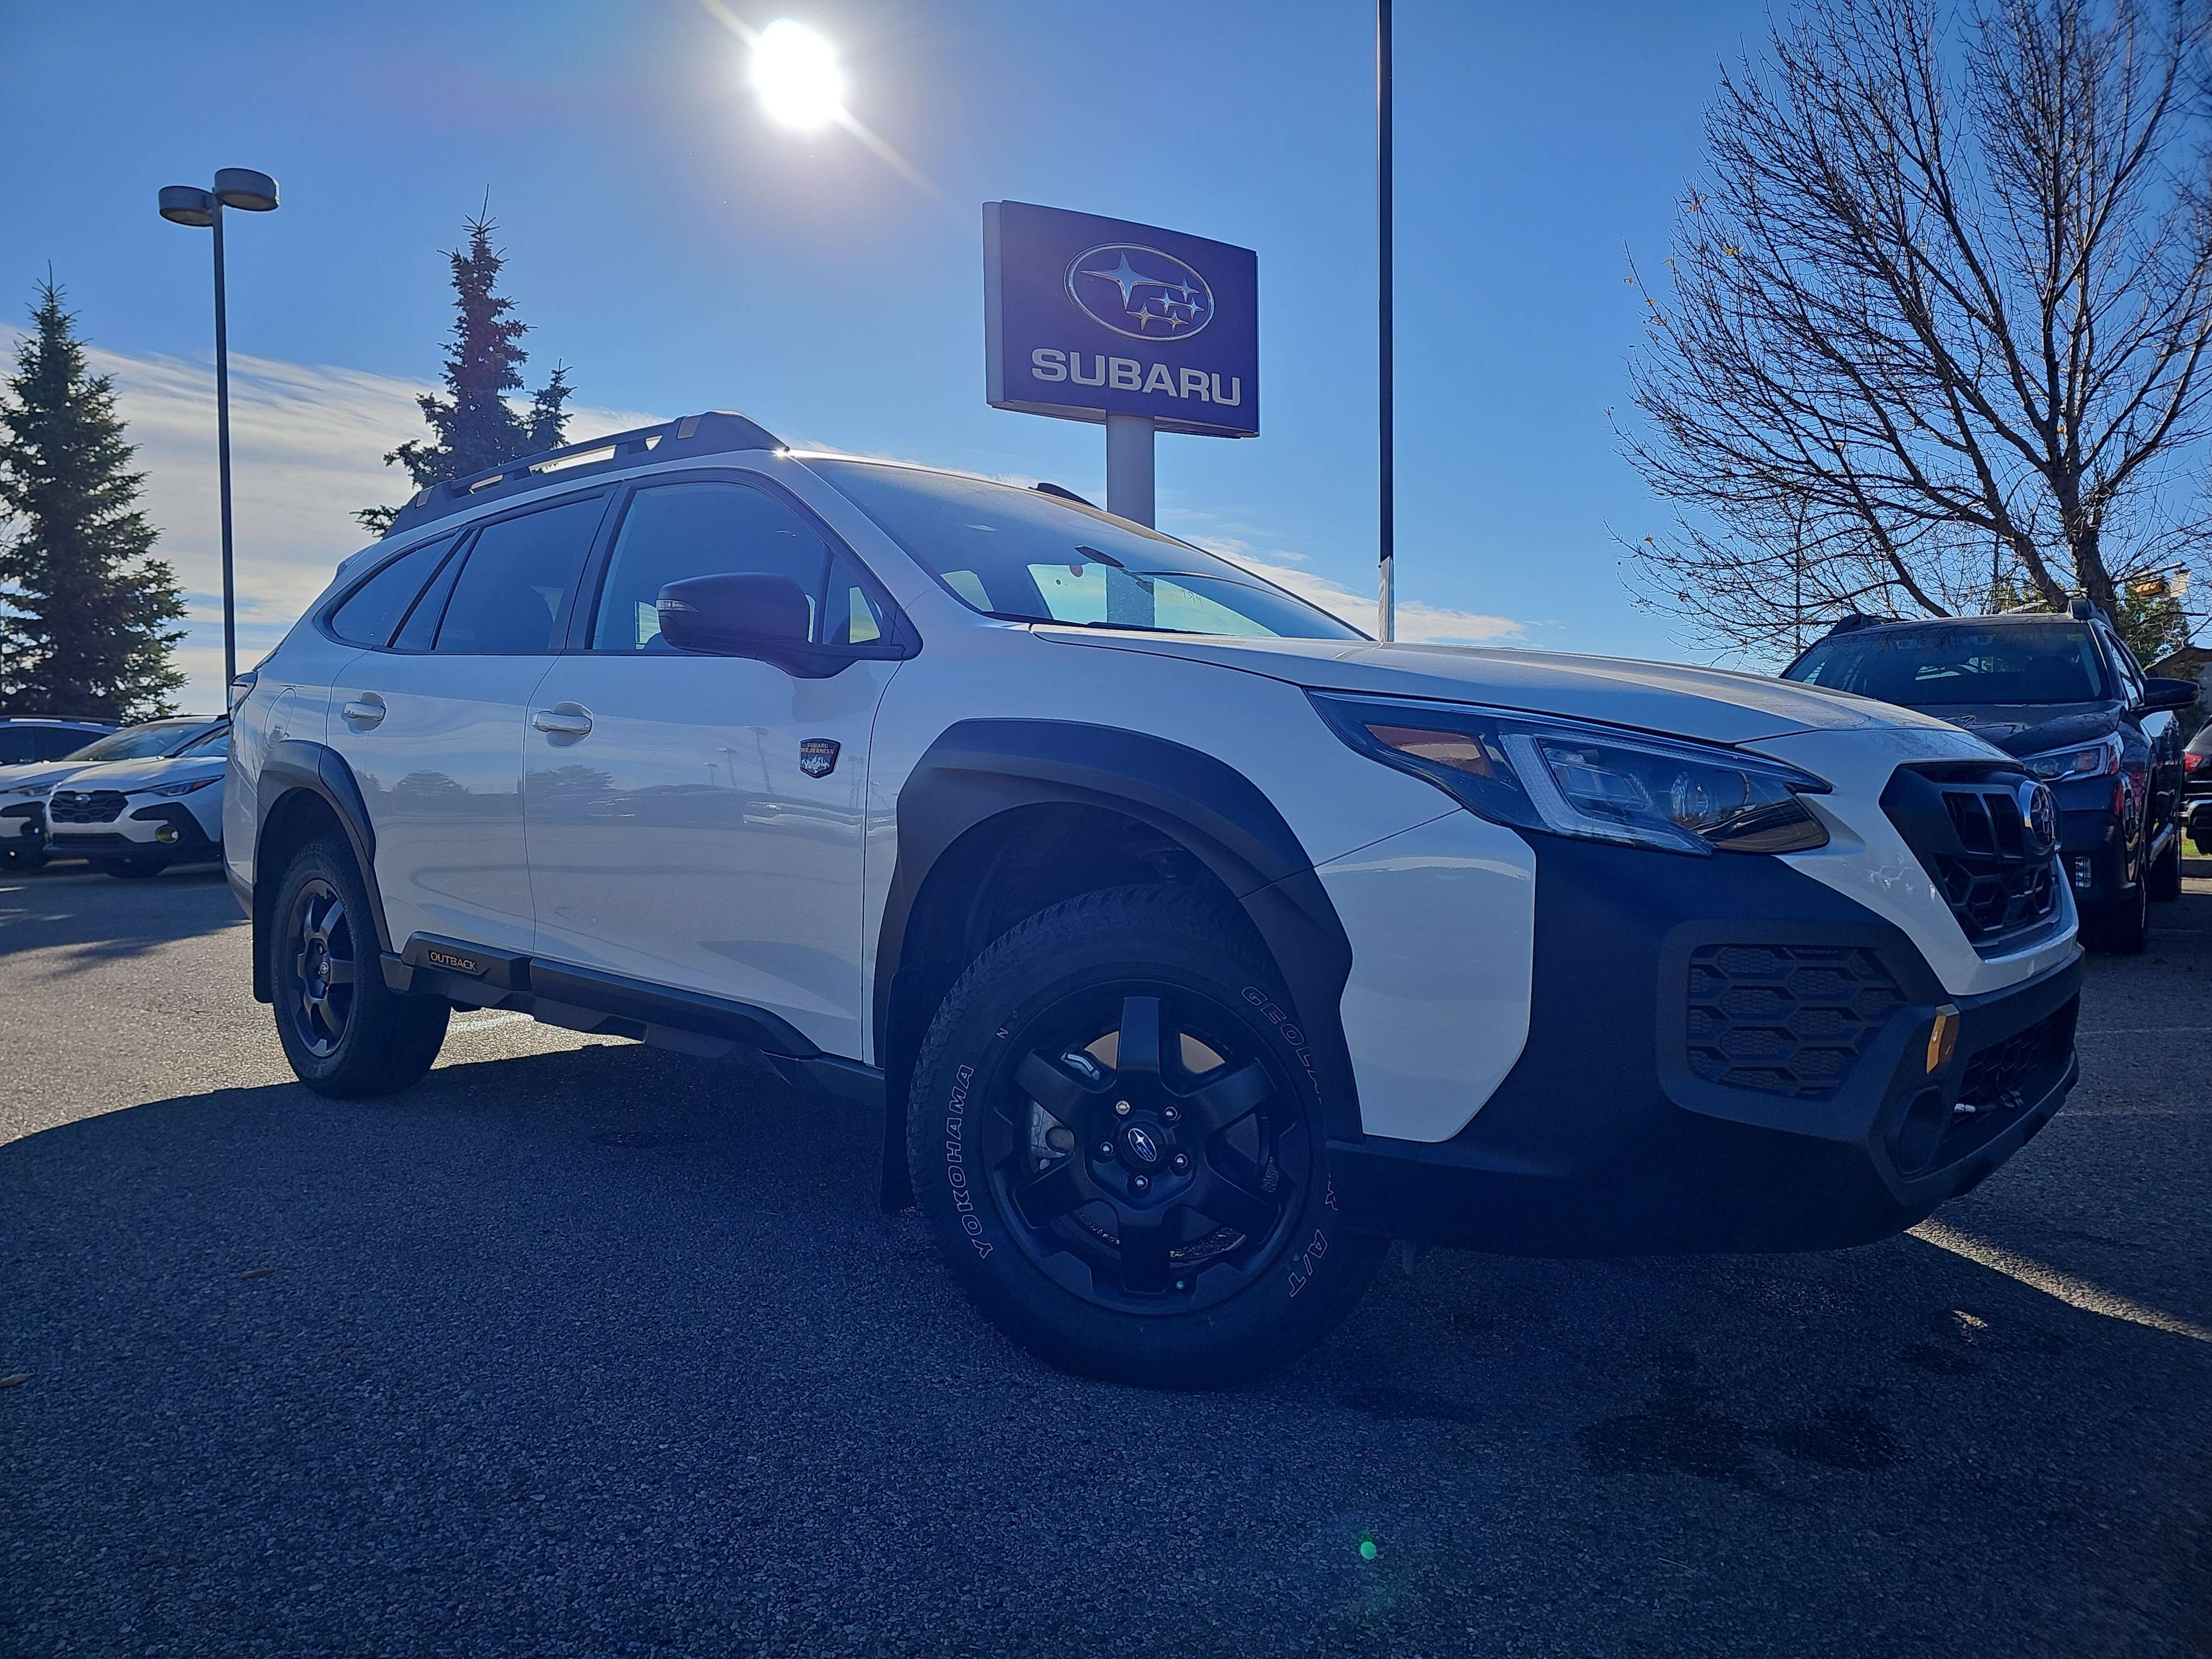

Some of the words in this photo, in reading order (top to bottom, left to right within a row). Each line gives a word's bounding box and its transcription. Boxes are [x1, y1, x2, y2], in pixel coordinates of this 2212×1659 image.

[1031, 348, 1241, 407] SUBARU
[430, 951, 477, 972] OUTBACK
[946, 1064, 994, 1260] YOKOHAMA
[1288, 1228, 1328, 1298] A/T
